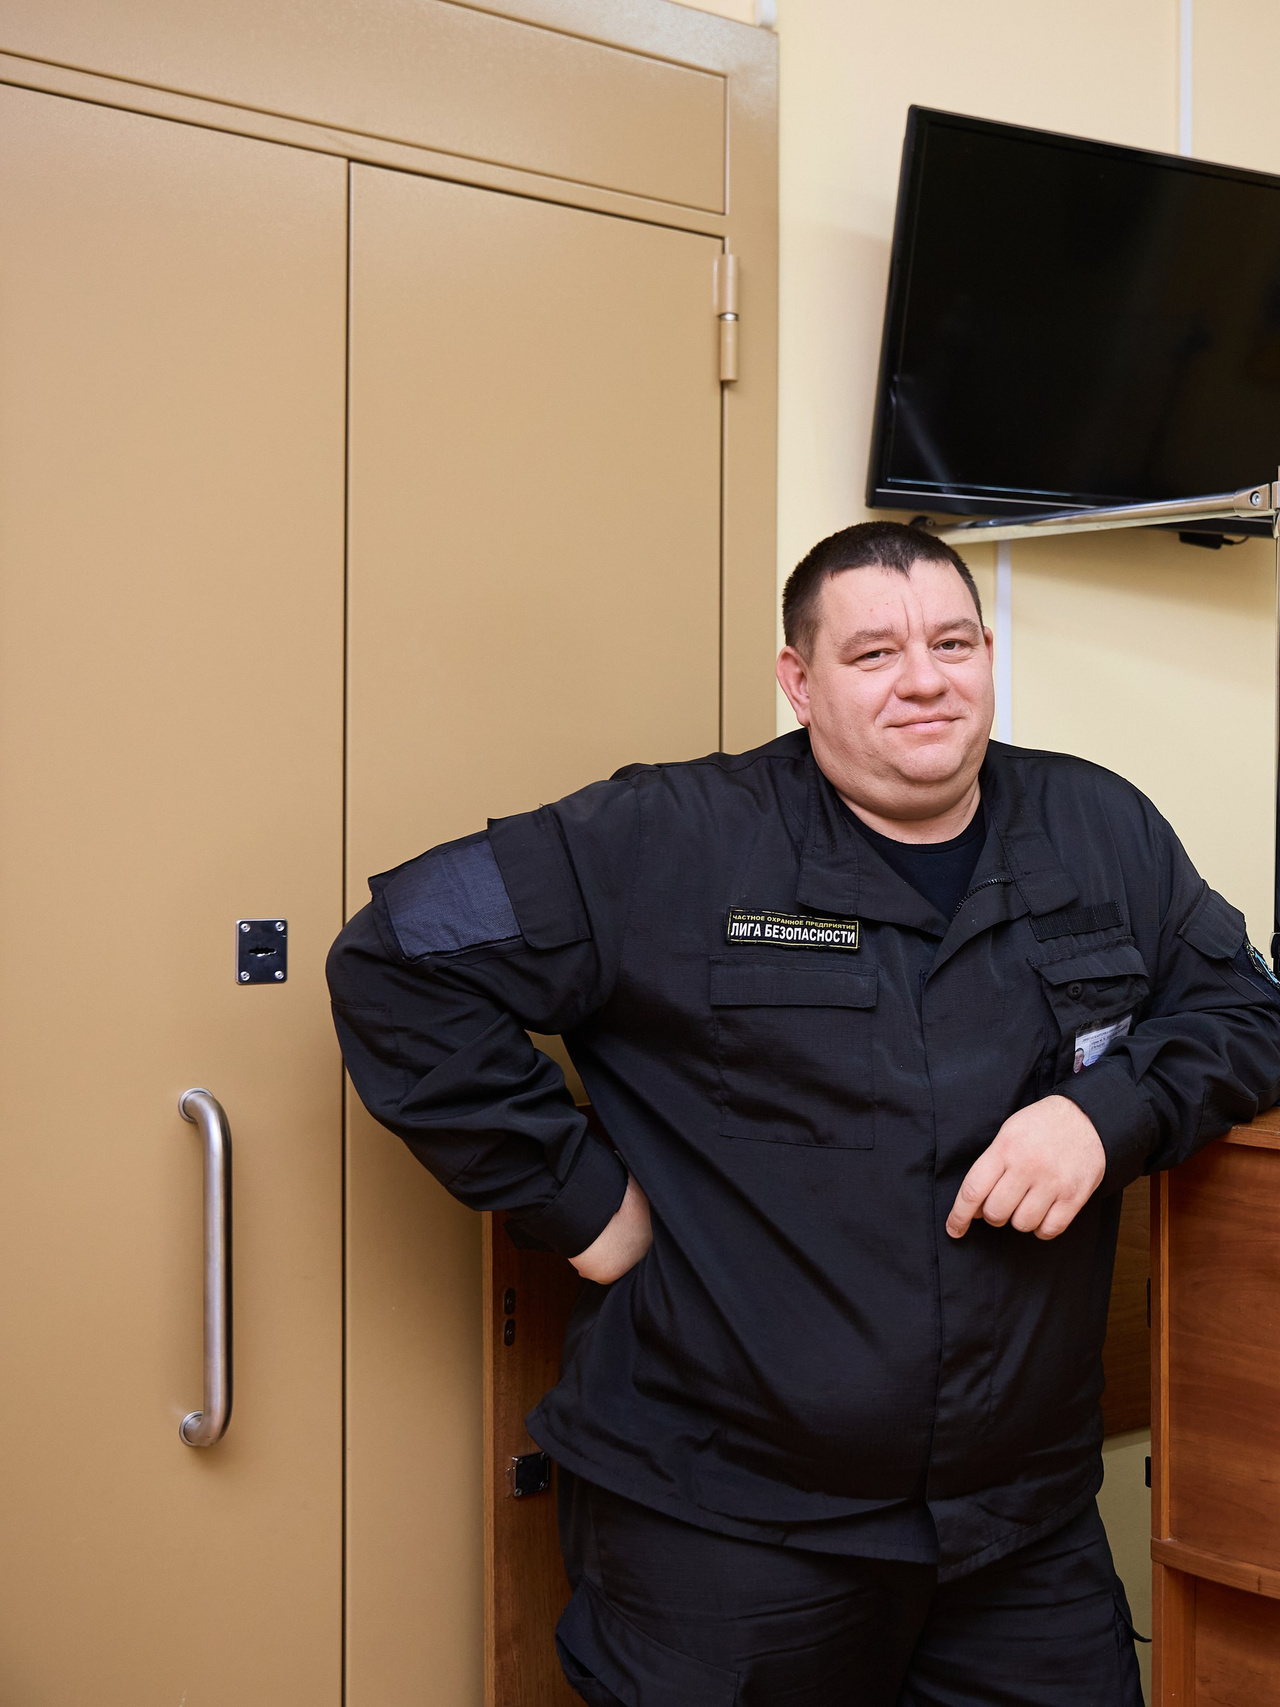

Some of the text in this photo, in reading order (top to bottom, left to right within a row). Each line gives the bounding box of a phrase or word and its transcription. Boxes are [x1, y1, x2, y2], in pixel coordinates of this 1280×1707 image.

[732, 914, 856, 930] ЧАСТНОЕ ОХРАННОЕ ПРЕДПРИЯТИЕ
[730, 922, 856, 944] ЛИГА БЕЗОПАСНОСТИ
